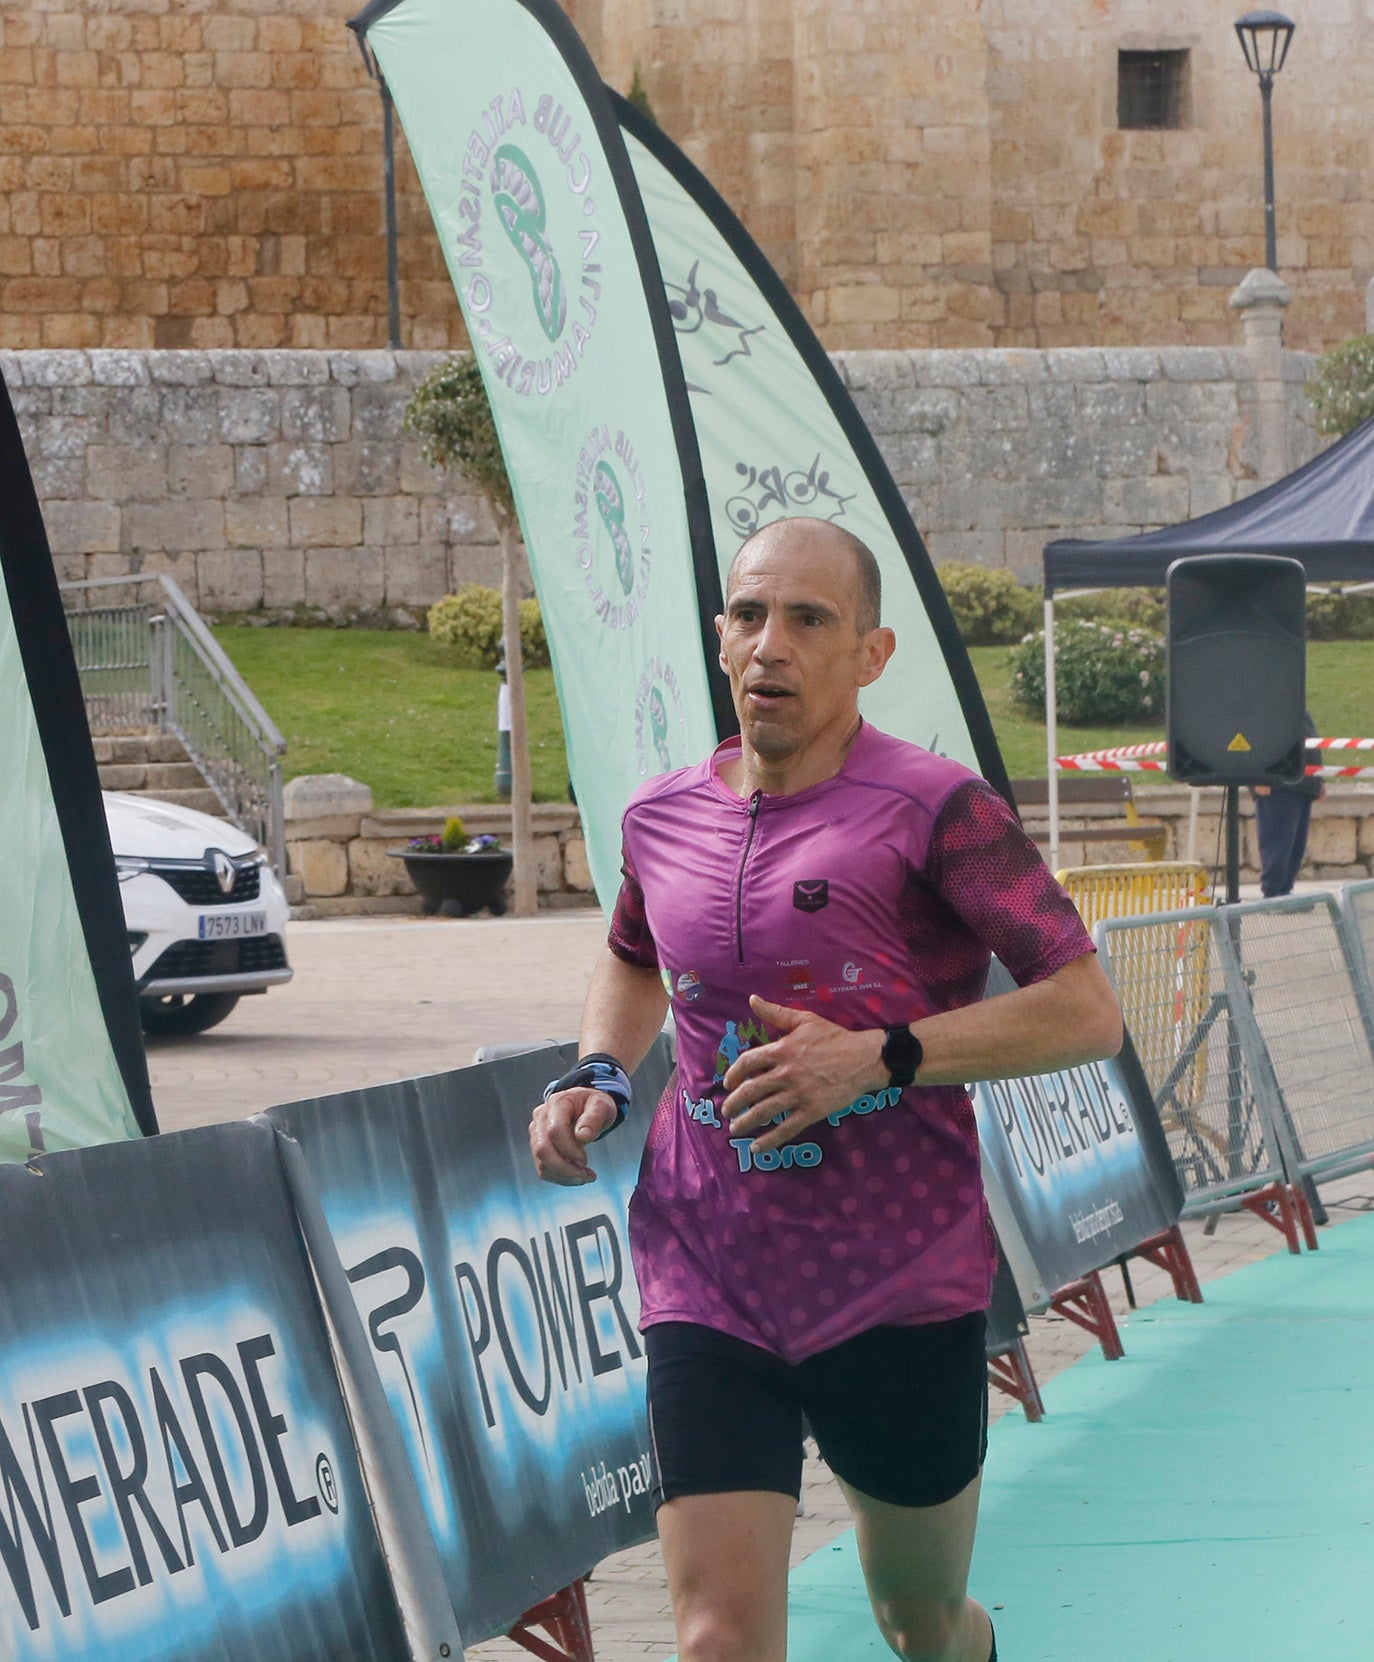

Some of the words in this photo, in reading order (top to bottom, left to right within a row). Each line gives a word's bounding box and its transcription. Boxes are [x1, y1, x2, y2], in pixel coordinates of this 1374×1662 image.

[208, 916, 239, 936] 7573
[991, 1062, 1128, 1178] POWERADE
[729, 1138, 823, 1173] Toro
[455, 1213, 648, 1428] POWER
[581, 1461, 620, 1517] bebida
